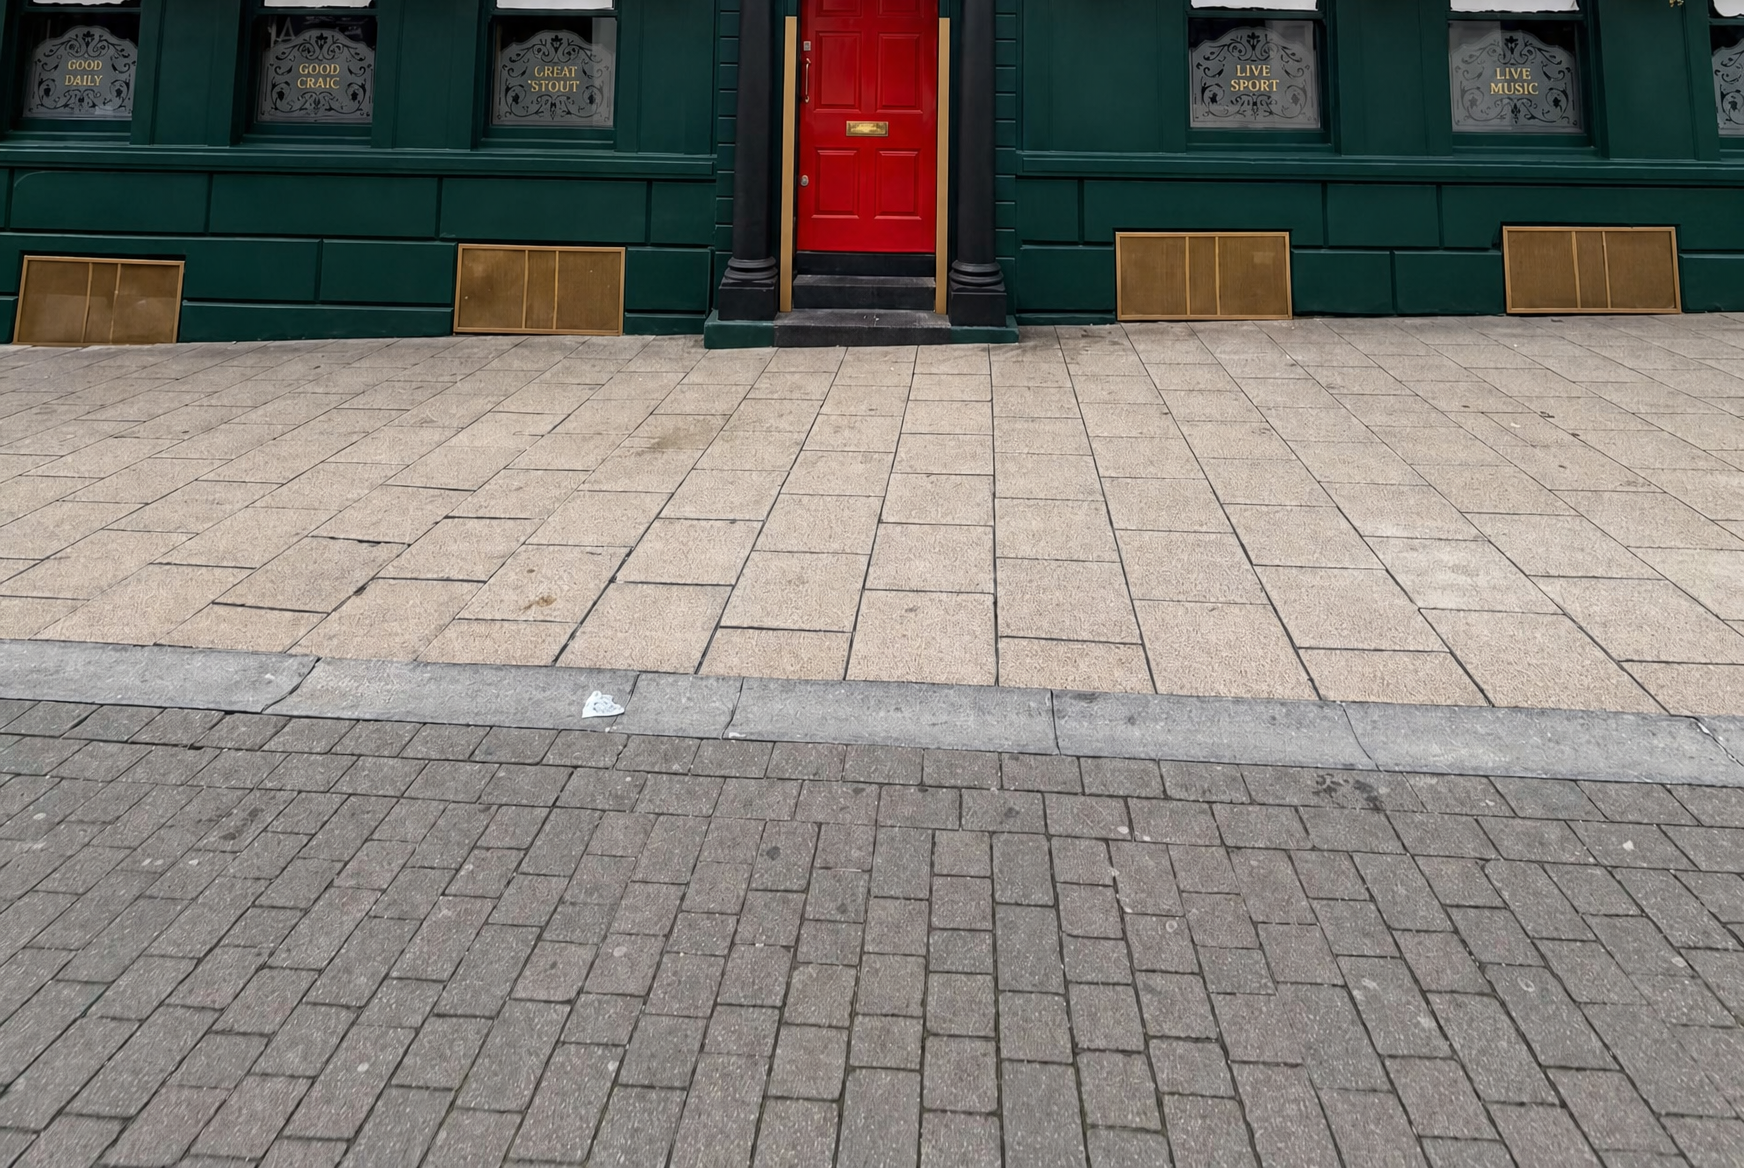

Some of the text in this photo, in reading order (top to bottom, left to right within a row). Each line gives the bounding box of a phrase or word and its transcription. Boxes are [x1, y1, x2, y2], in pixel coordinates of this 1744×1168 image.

[68, 59, 102, 71] GOOD
[299, 63, 340, 75] GOOD
[534, 65, 578, 78] GREAT
[1236, 64, 1271, 77] LIVE
[64, 74, 103, 86] DAILY
[1495, 67, 1532, 80] LIVE
[297, 76, 340, 89] CRAIC
[1230, 79, 1280, 92] SPORT
[1490, 82, 1539, 95] MUSIC
